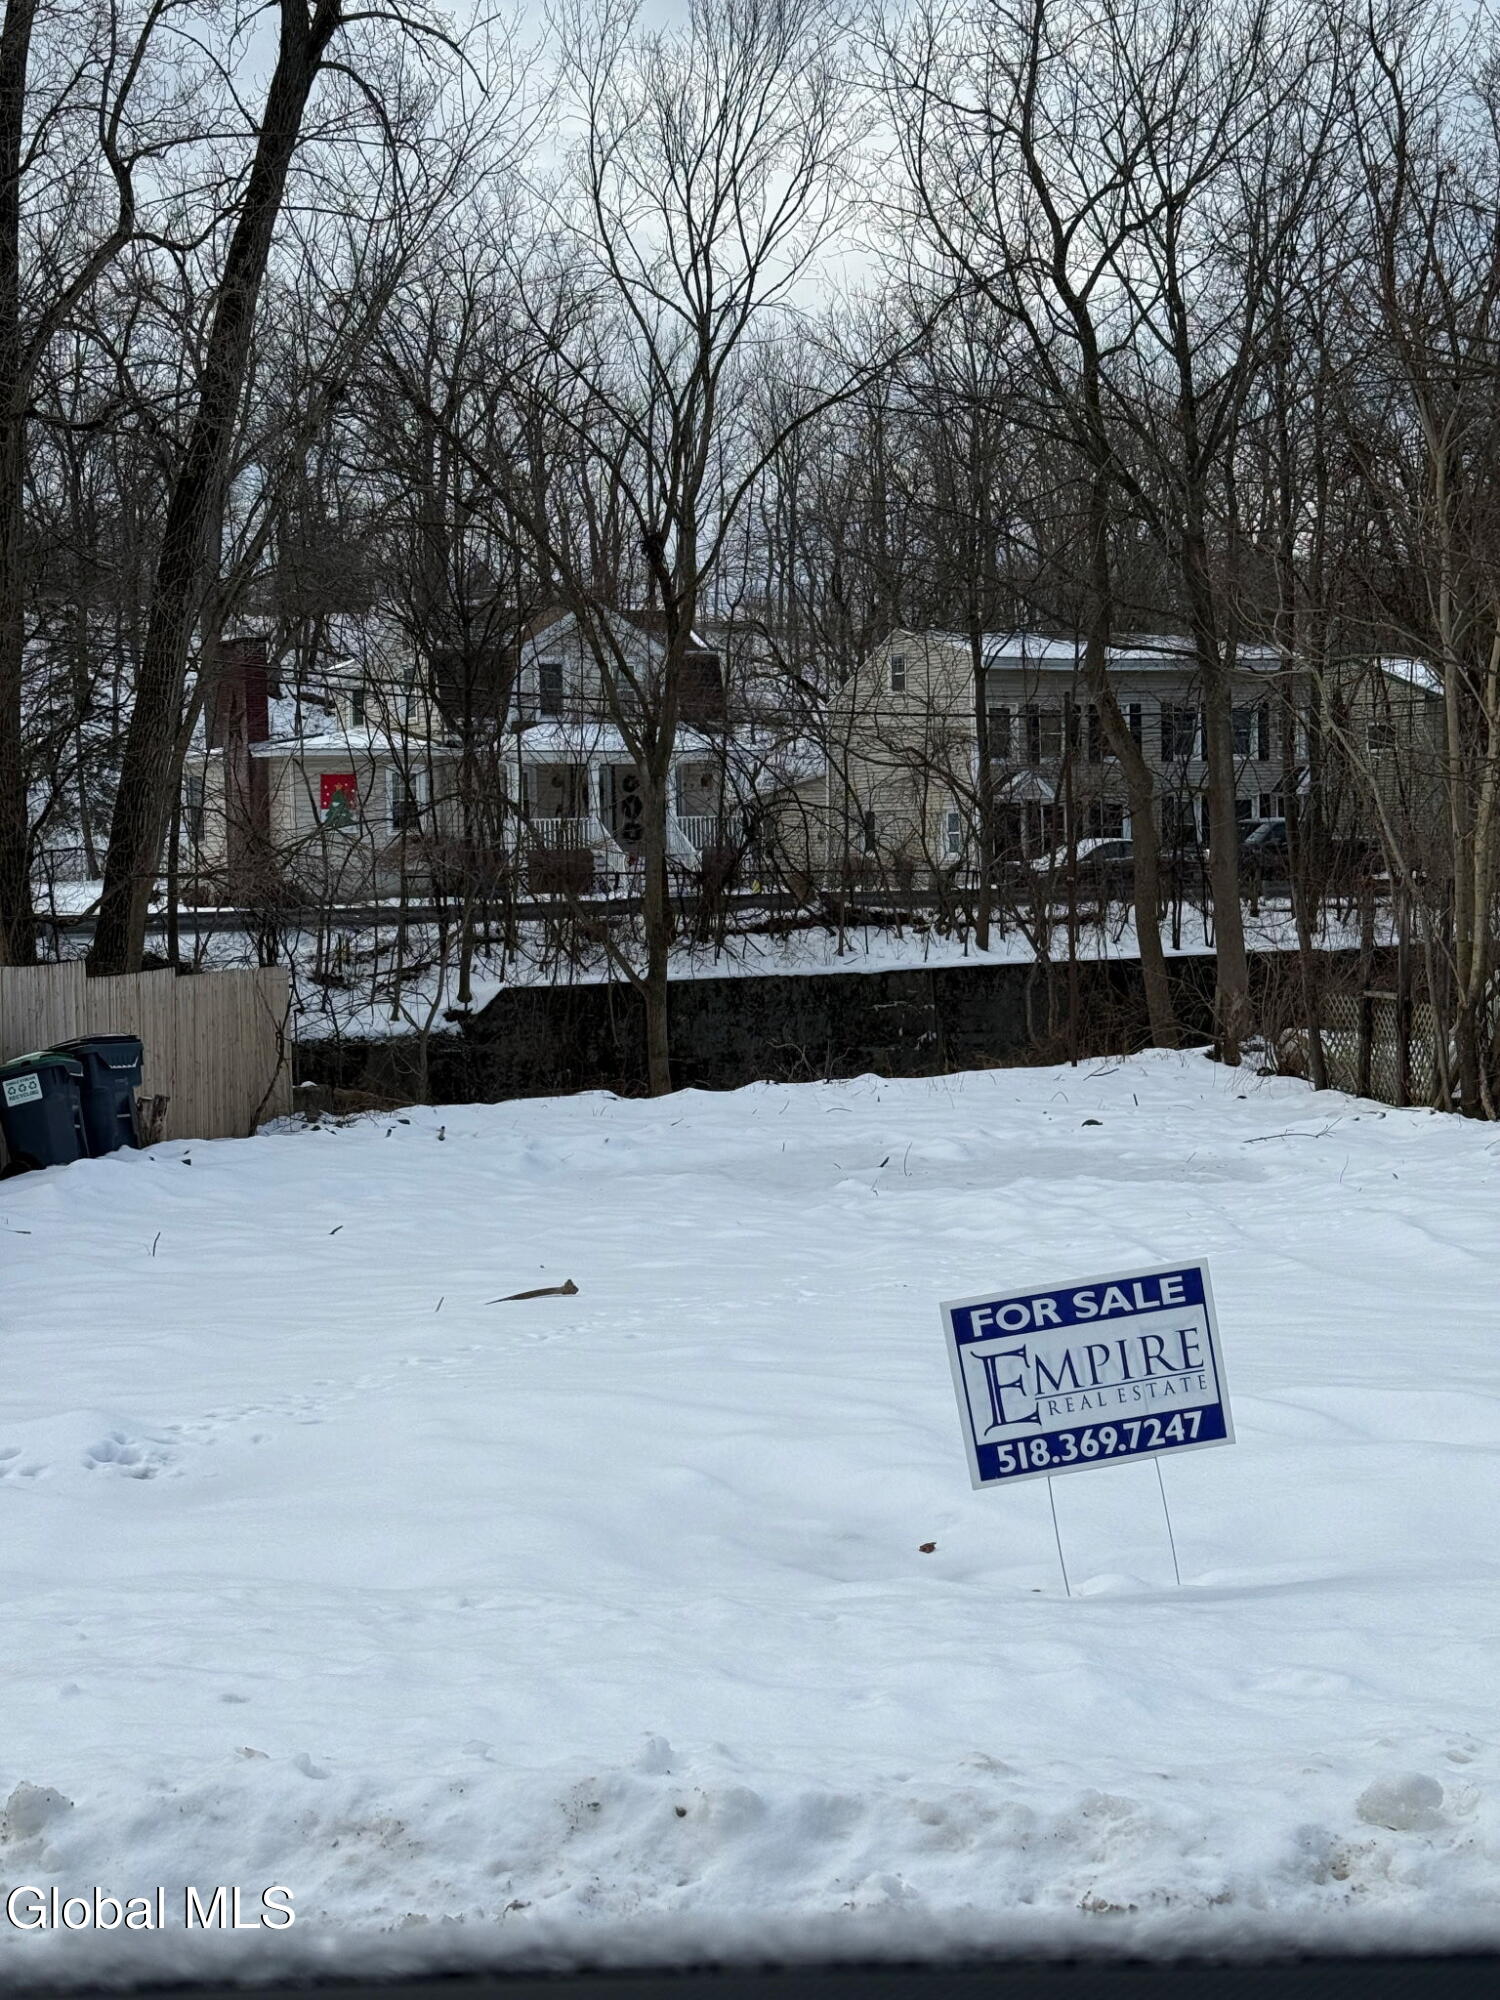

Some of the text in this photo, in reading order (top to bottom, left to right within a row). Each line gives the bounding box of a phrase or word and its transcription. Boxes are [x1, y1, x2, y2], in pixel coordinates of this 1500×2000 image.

[970, 1275, 1186, 1337] FOR SALE
[970, 1327, 1204, 1436] EMPIRE
[1048, 1374, 1208, 1416] REAL ESTATE
[997, 1410, 1203, 1474] 518.369.7247
